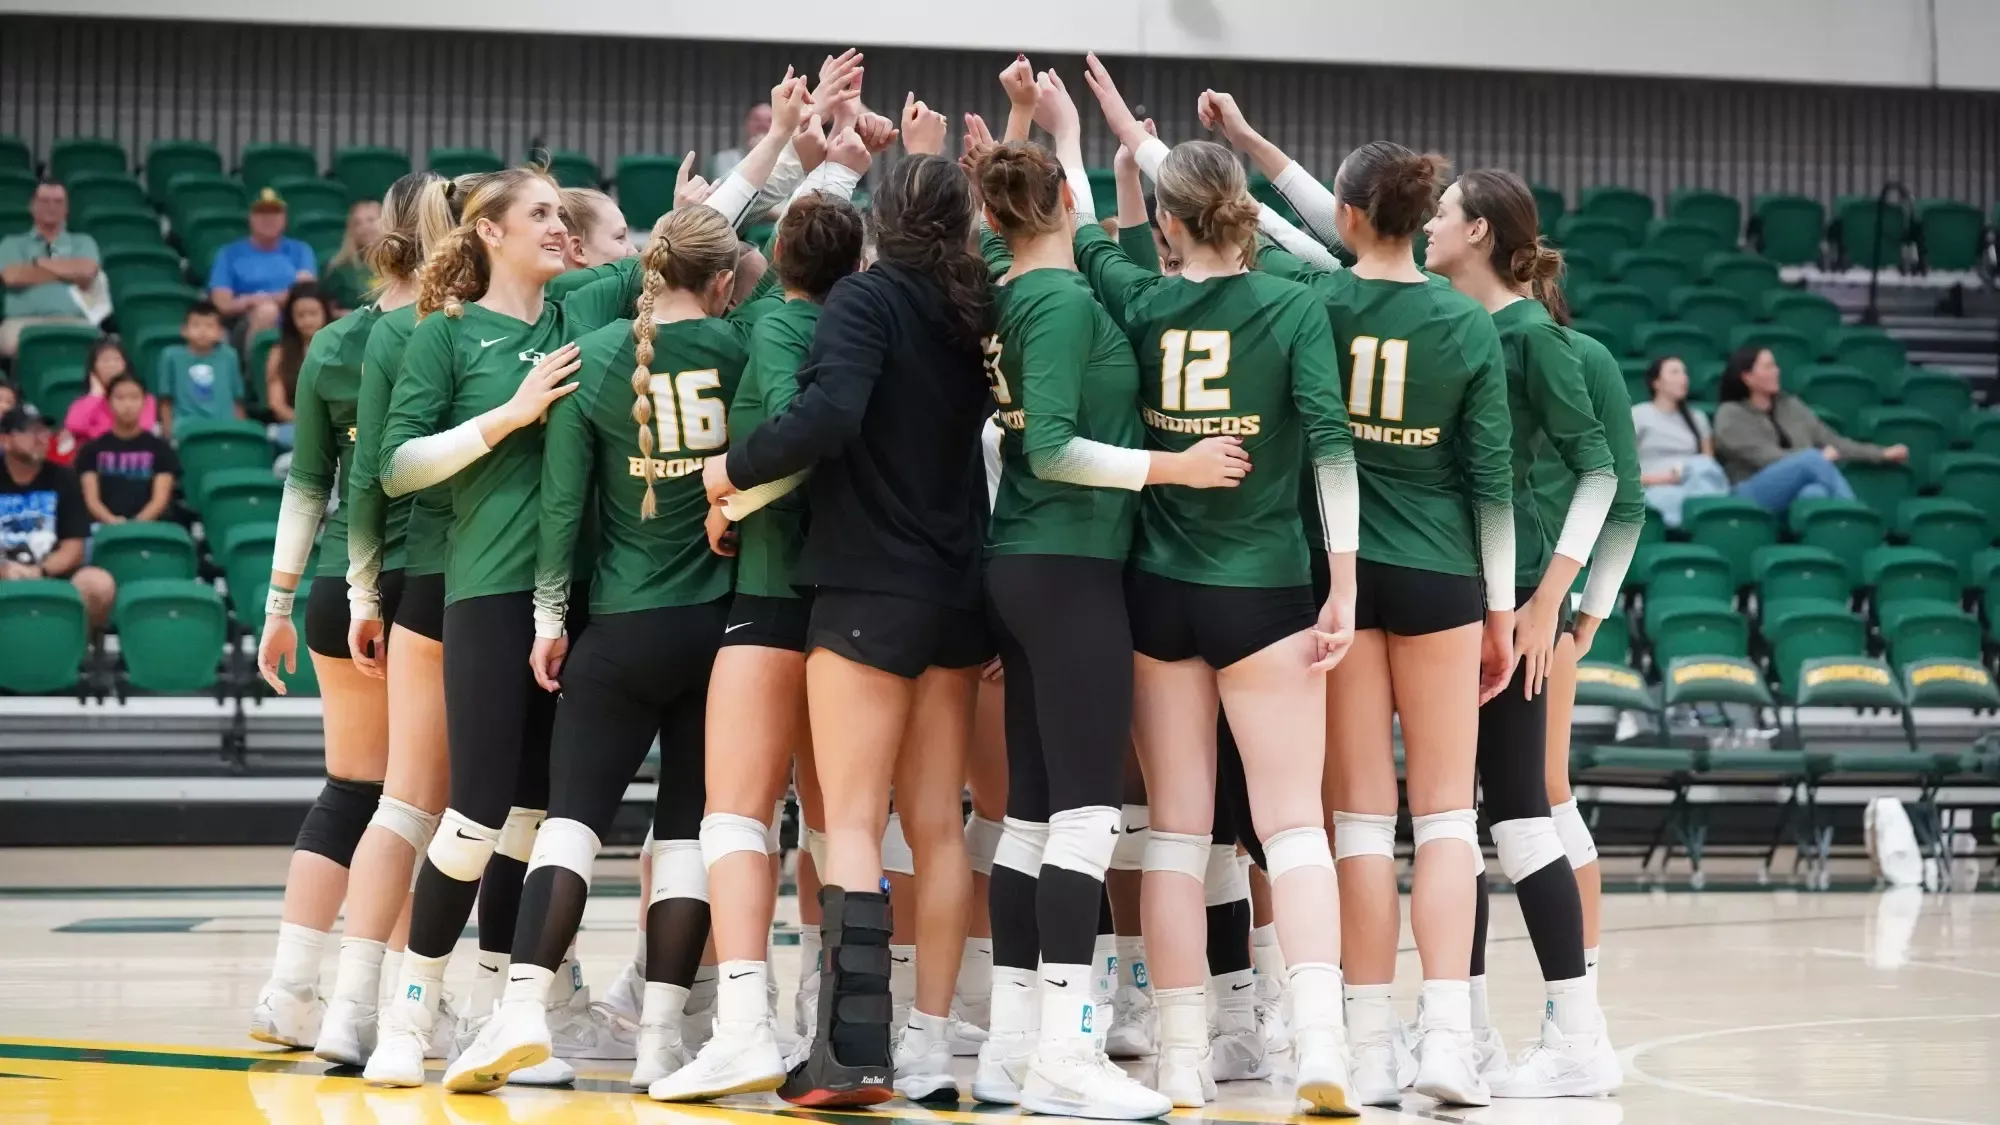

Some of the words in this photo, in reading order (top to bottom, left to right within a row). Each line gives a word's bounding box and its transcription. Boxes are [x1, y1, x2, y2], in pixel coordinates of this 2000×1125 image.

[1160, 329, 1231, 411] 12
[1348, 335, 1409, 421] 11
[648, 368, 728, 452] 16
[1142, 407, 1261, 435] BRONCOS
[1348, 421, 1441, 446] ONCOS
[628, 456, 704, 478] BRON
